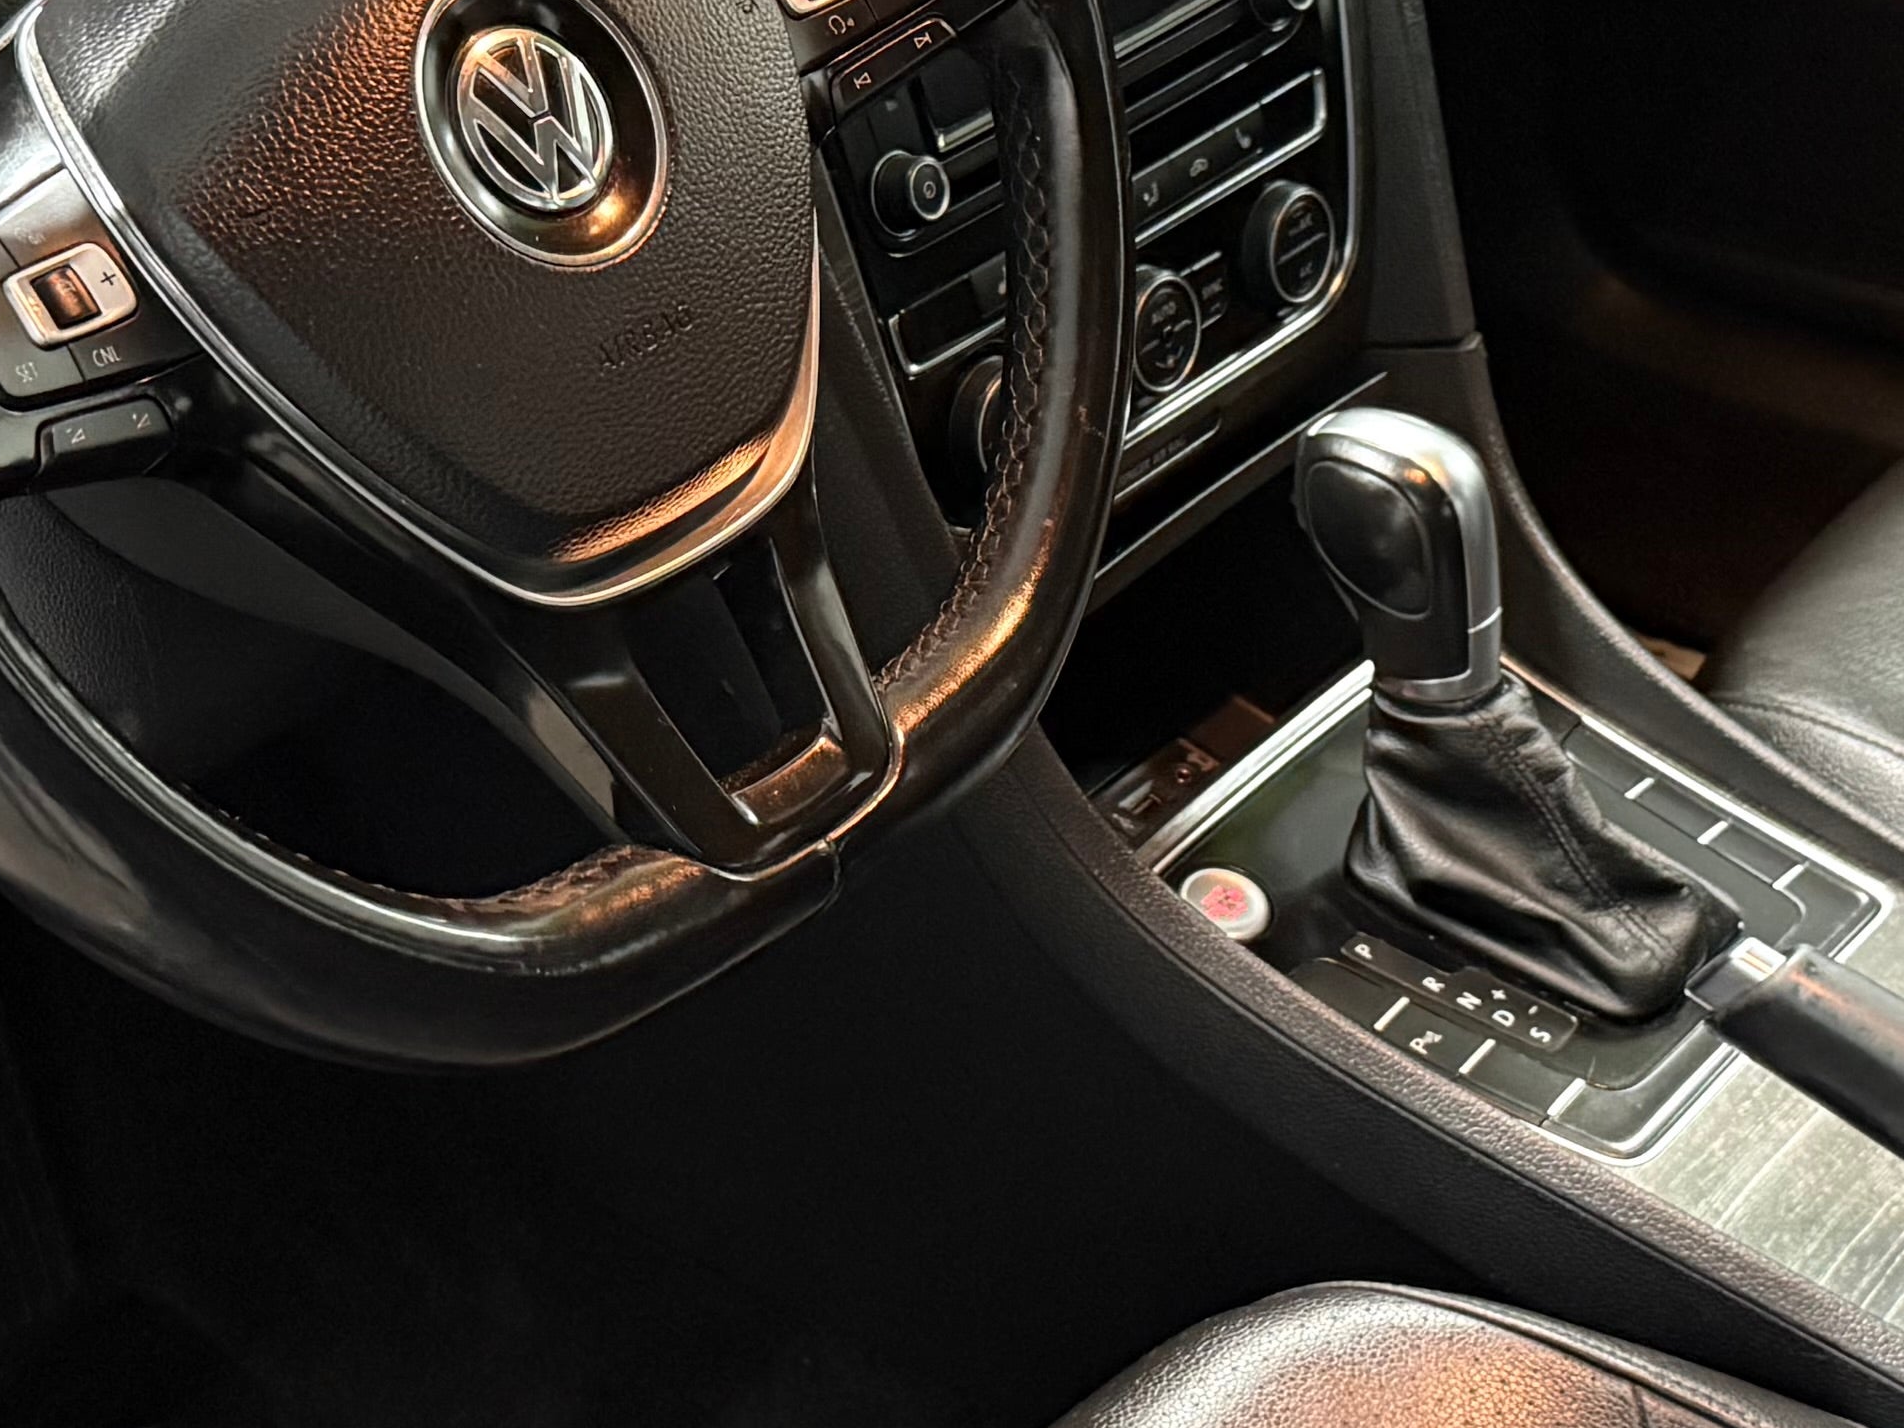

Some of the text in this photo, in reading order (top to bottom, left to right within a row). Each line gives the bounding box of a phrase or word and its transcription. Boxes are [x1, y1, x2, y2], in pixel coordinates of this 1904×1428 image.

[92, 346, 122, 368] CNL
[1354, 942, 1552, 1044] P R N D S
